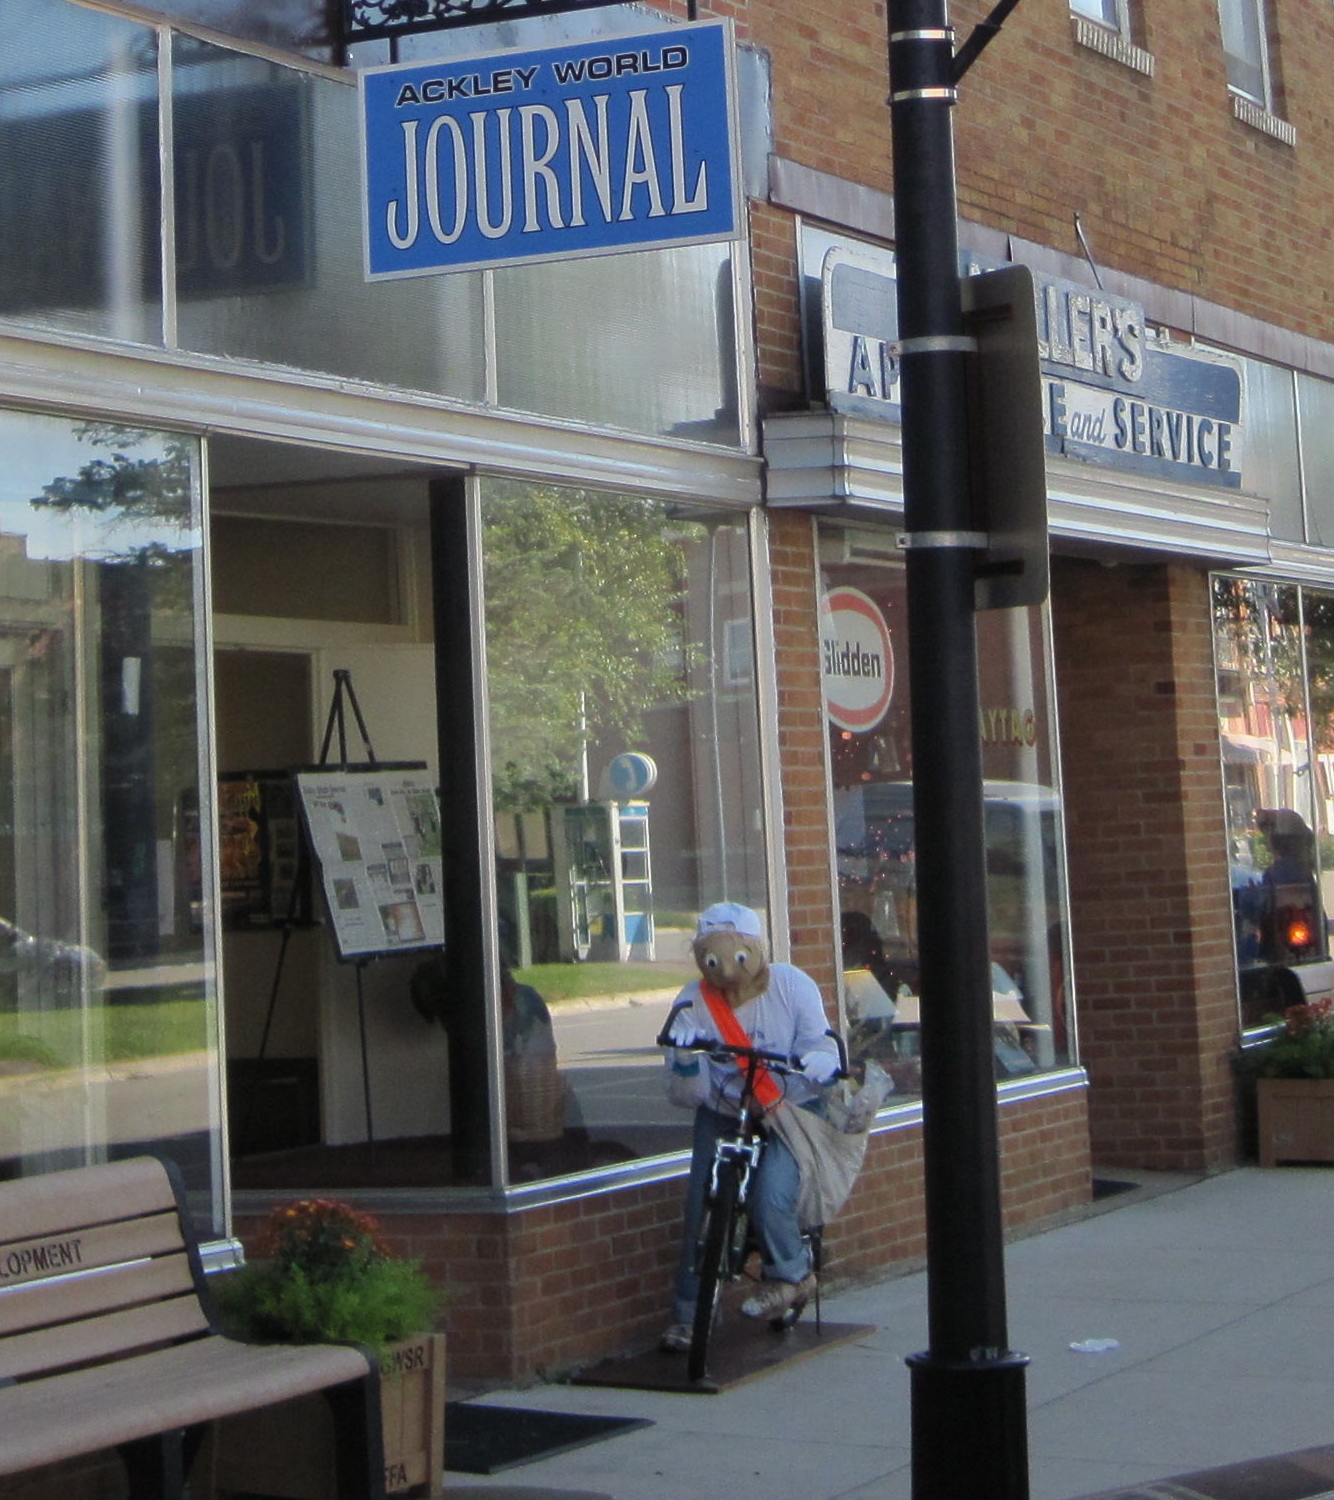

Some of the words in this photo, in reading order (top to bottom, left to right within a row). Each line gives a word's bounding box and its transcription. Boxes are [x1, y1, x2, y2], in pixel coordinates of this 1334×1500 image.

[395, 64, 539, 108] ACKLEY
[553, 45, 689, 84] WORLD
[386, 82, 709, 250] JOURNAL
[1070, 407, 1107, 446] and
[1113, 397, 1233, 472] SERVICE
